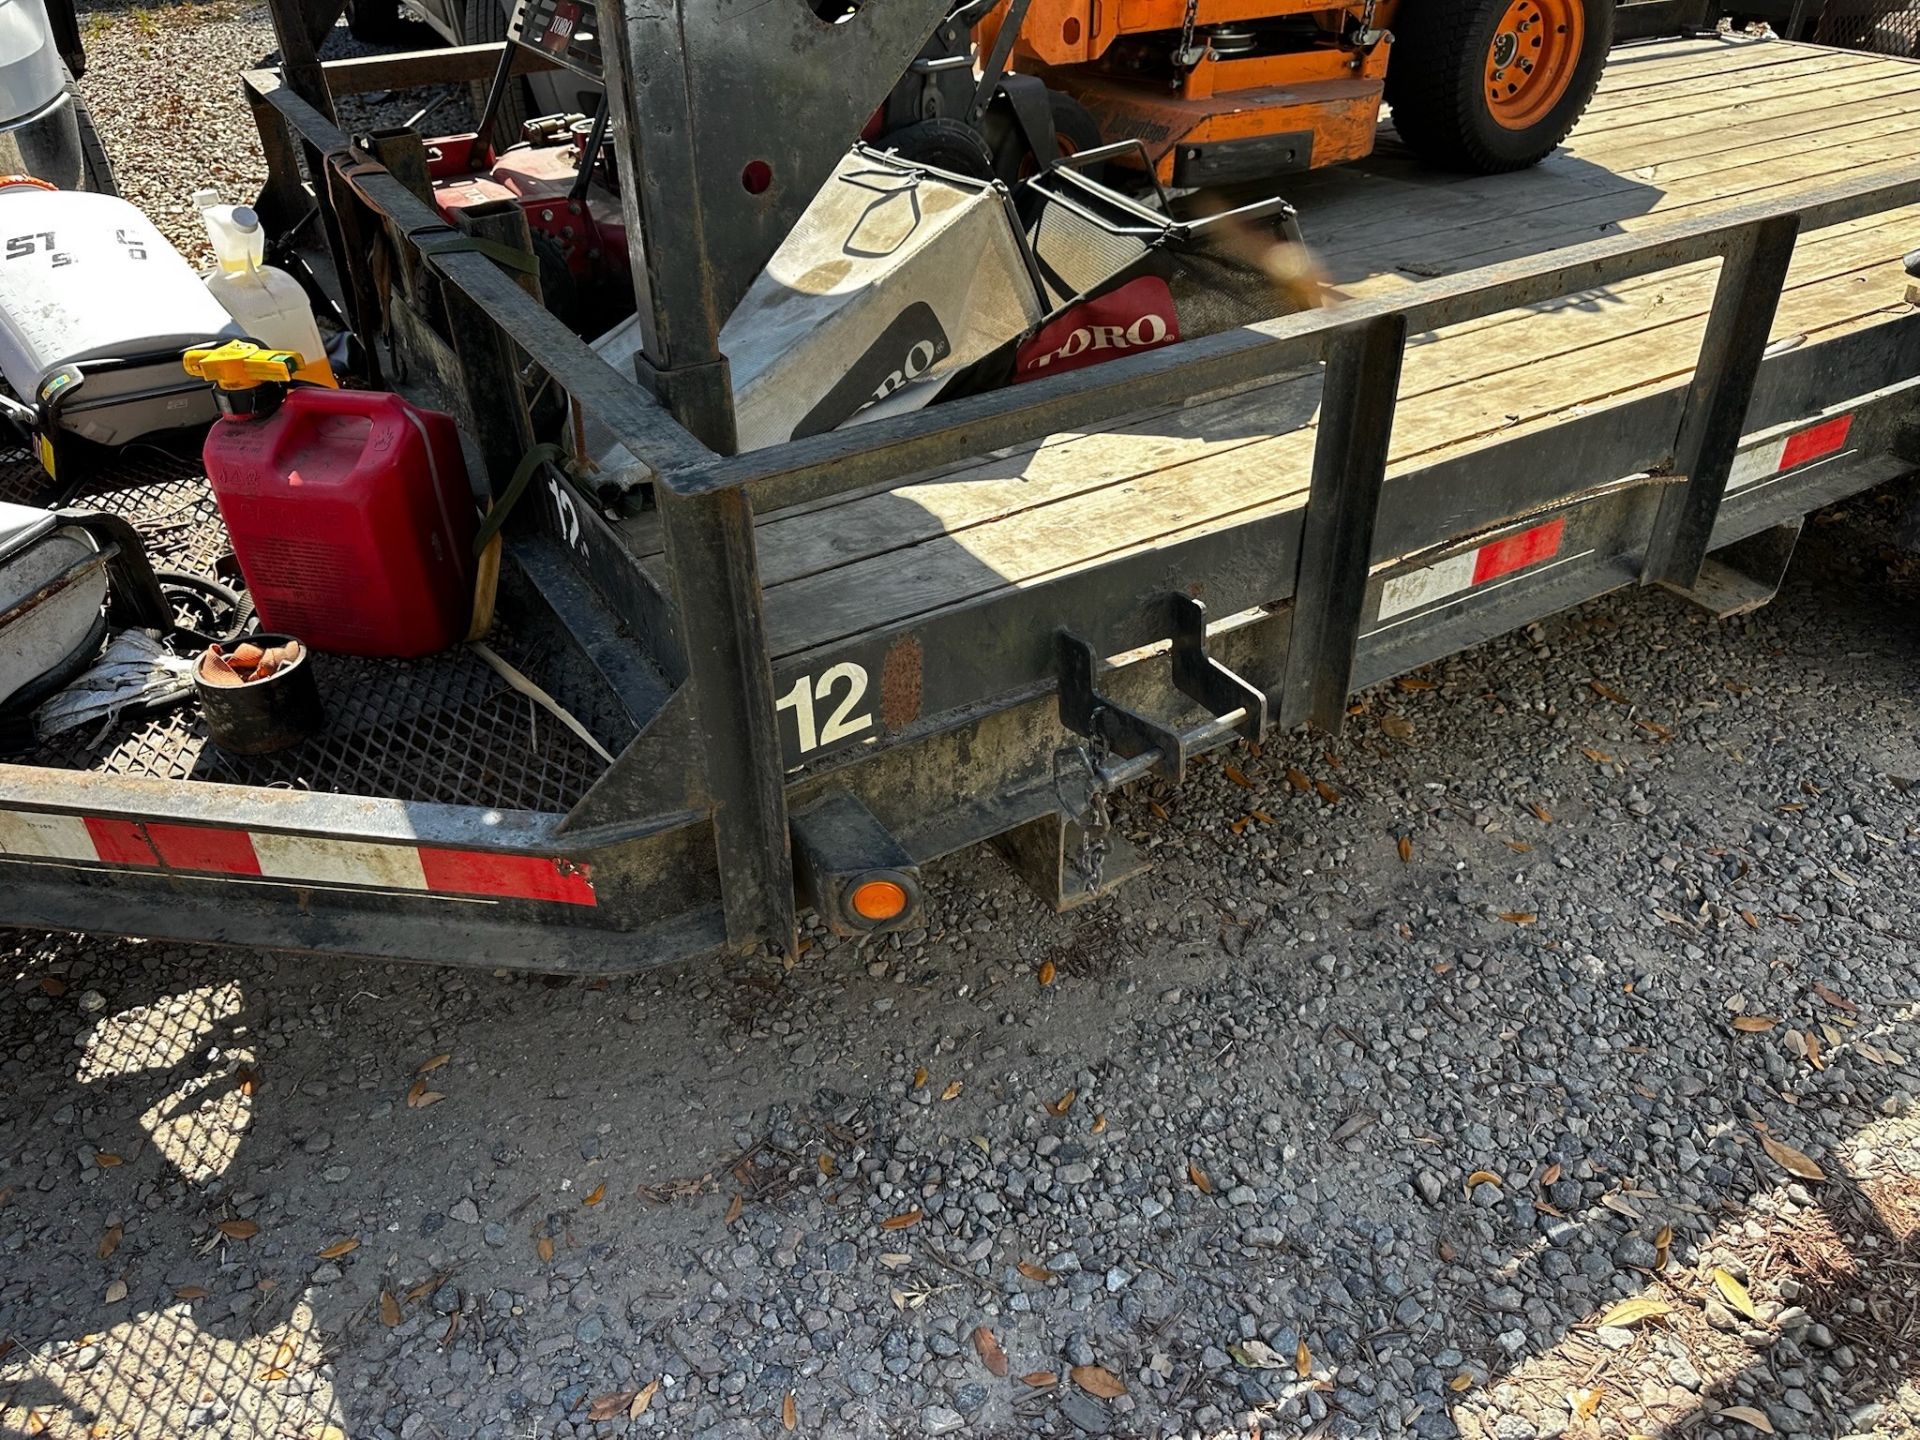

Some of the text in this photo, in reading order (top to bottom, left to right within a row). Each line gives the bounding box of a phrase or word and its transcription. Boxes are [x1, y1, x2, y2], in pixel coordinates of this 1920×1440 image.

[550, 15, 574, 39] TORO
[851, 340, 935, 417] RO
[776, 662, 872, 753] 12
